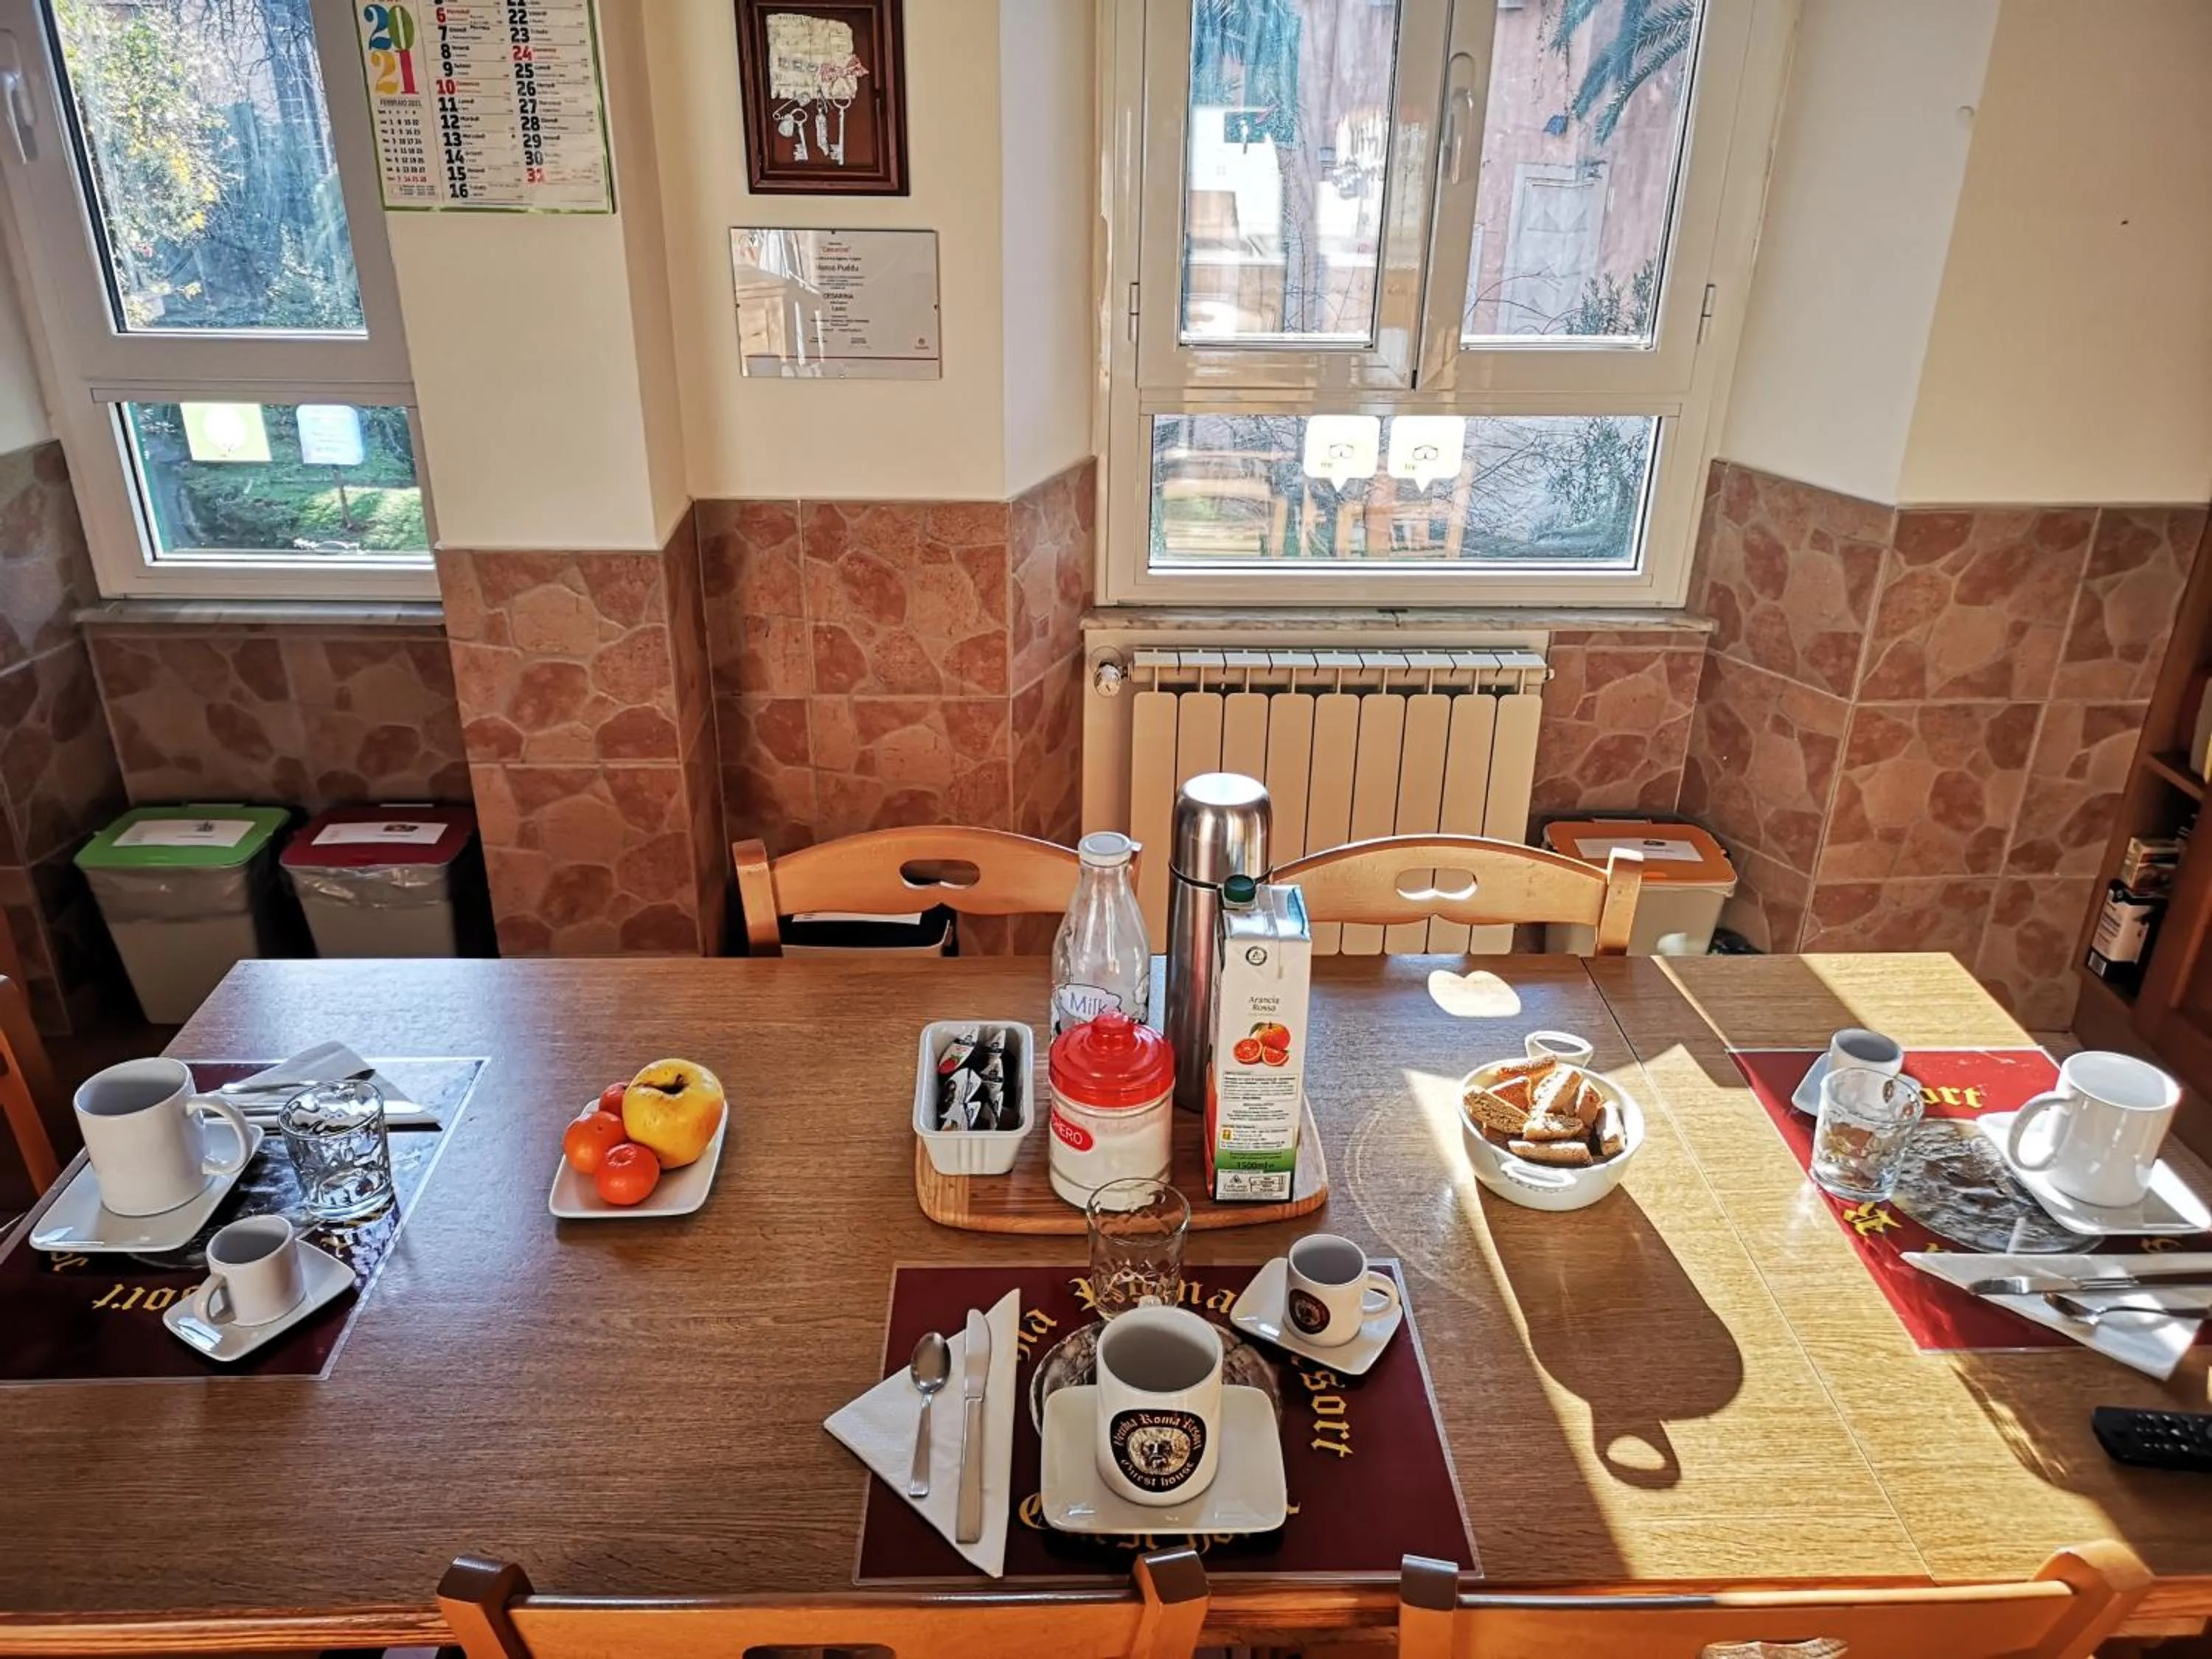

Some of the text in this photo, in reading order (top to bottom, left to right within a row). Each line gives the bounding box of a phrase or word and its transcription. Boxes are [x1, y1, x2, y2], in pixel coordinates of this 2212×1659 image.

[437, 7, 446, 23] 6
[508, 9, 528, 24] 22
[438, 25, 447, 41] 7
[510, 27, 529, 43] 23
[441, 43, 451, 59] 8
[512, 45, 532, 60] 24
[443, 61, 453, 77] 9
[514, 63, 534, 78] 25
[437, 79, 456, 94] 10
[517, 81, 536, 97] 26
[438, 97, 458, 112] 11
[519, 99, 537, 114] 27
[440, 114, 460, 129] 12
[521, 116, 540, 131] 28
[443, 132, 462, 147] 13
[523, 133, 542, 148] 29
[445, 149, 465, 164] 14
[524, 150, 543, 165] 30
[448, 166, 466, 181] 15
[450, 183, 468, 198] 16
[1071, 992, 1107, 1015] Milk
[1249, 995, 1279, 1004] Arancia
[1138, 1413, 1180, 1425] Roma
